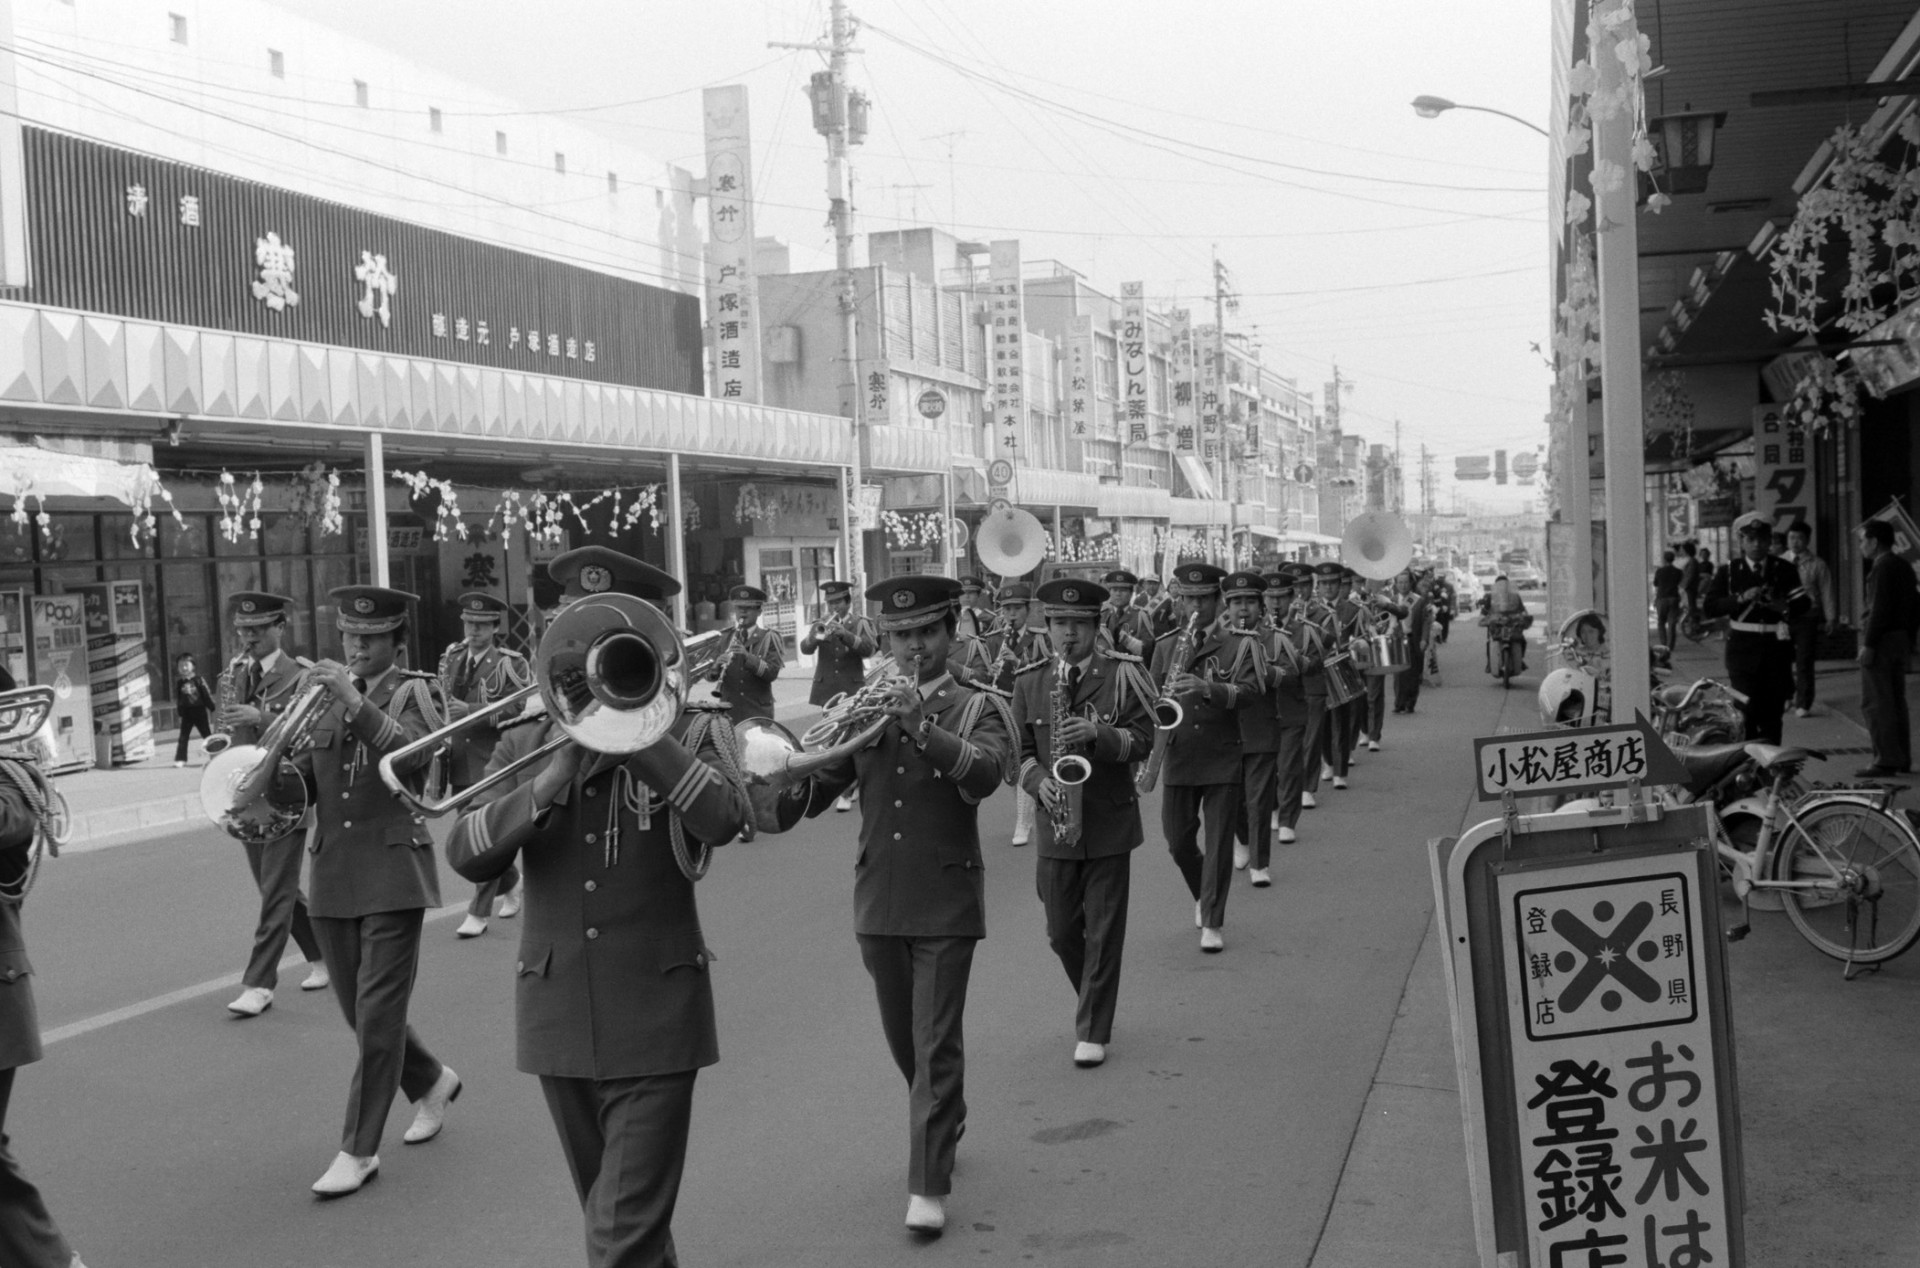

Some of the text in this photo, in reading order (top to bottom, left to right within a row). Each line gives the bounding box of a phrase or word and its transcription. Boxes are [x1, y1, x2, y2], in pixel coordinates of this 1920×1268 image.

[127, 183, 200, 227] 清酒
[1125, 321, 1148, 442] みなしん薬局
[1003, 414, 1018, 447] 本社
[1763, 411, 1781, 465] 合同
[994, 466, 1008, 478] 40
[45, 602, 74, 625] pop
[1487, 736, 1646, 787] 小松屋商店
[1526, 907, 1556, 1025] 登録店
[1659, 889, 1688, 1005] 長野県
[1624, 1041, 1713, 1268] お米は
